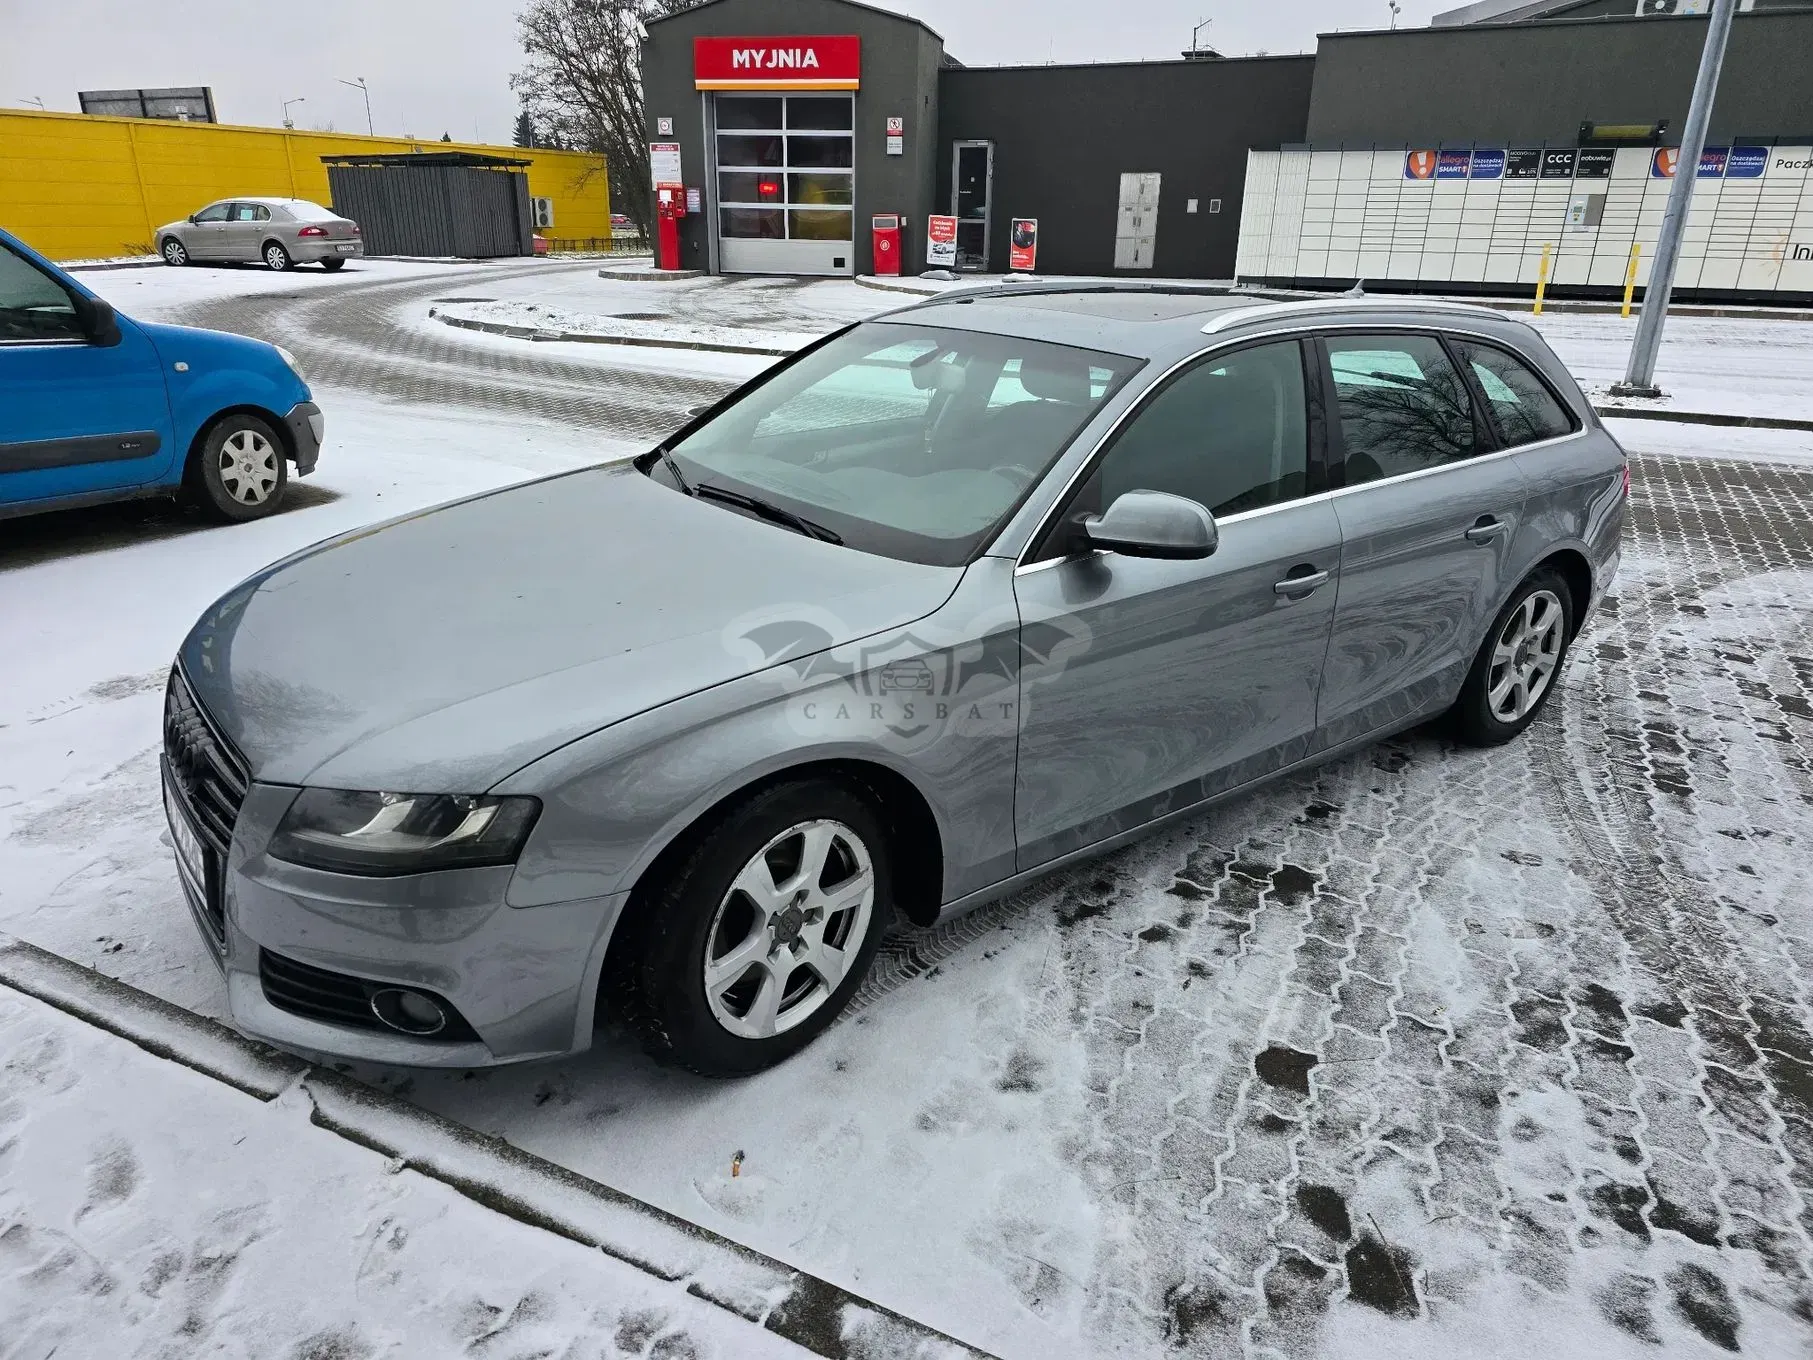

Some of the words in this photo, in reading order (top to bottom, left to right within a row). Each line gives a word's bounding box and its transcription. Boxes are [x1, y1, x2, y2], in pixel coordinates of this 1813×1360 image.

[732, 48, 819, 68] MYJNIA
[1440, 154, 1470, 165] allegro
[1547, 154, 1572, 164] CCC
